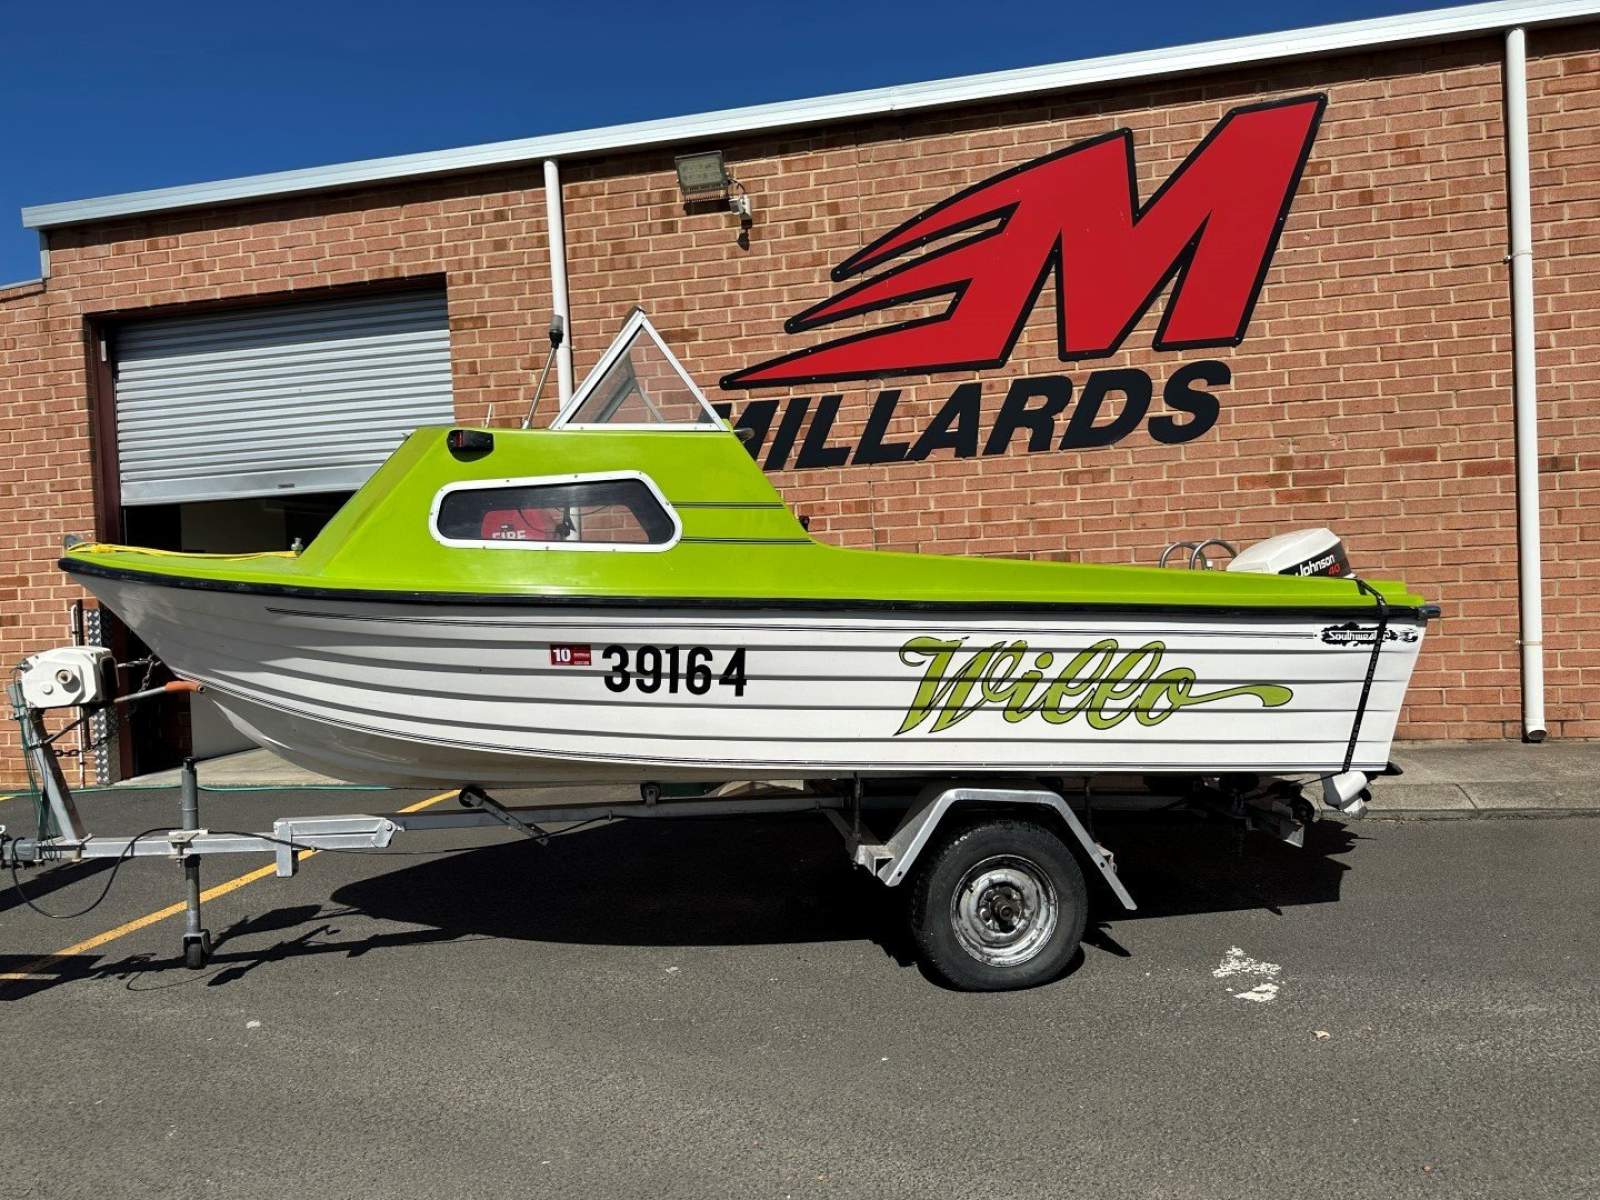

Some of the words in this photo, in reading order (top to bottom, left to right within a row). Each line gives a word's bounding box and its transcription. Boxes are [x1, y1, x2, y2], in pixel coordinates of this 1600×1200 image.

[711, 360, 1232, 471] MILLARDS
[1295, 554, 1335, 577] Johnson
[1328, 563, 1341, 576] 40
[552, 647, 571, 662] 10
[602, 645, 748, 698] 39164
[892, 635, 1294, 737] Willo
